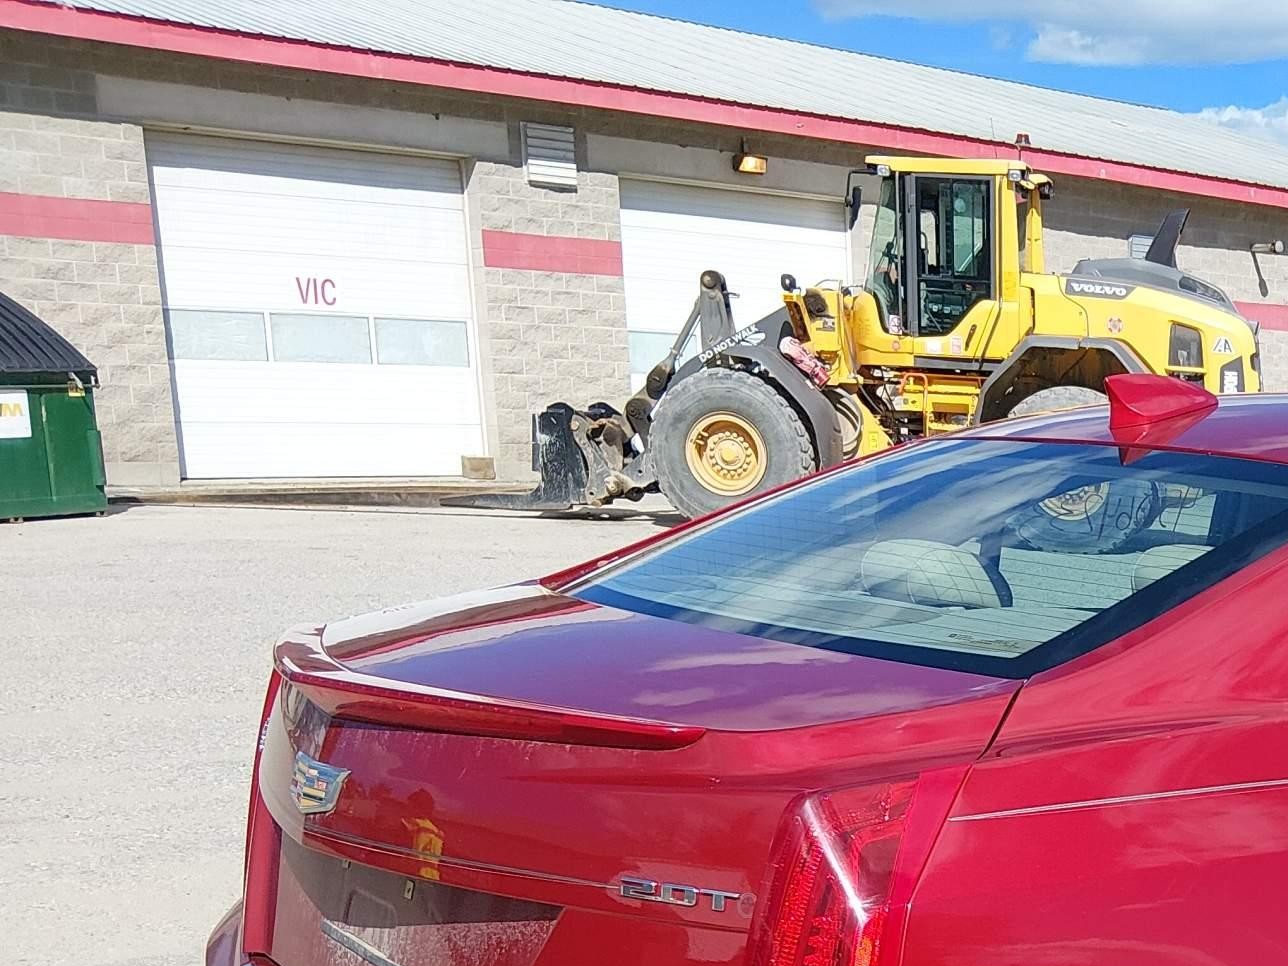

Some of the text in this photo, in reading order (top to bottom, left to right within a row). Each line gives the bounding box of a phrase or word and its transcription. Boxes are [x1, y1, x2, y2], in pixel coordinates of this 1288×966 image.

[295, 276, 337, 306] VIC
[1070, 282, 1127, 297] VOLVO
[698, 323, 759, 363] DO NOT WALK
